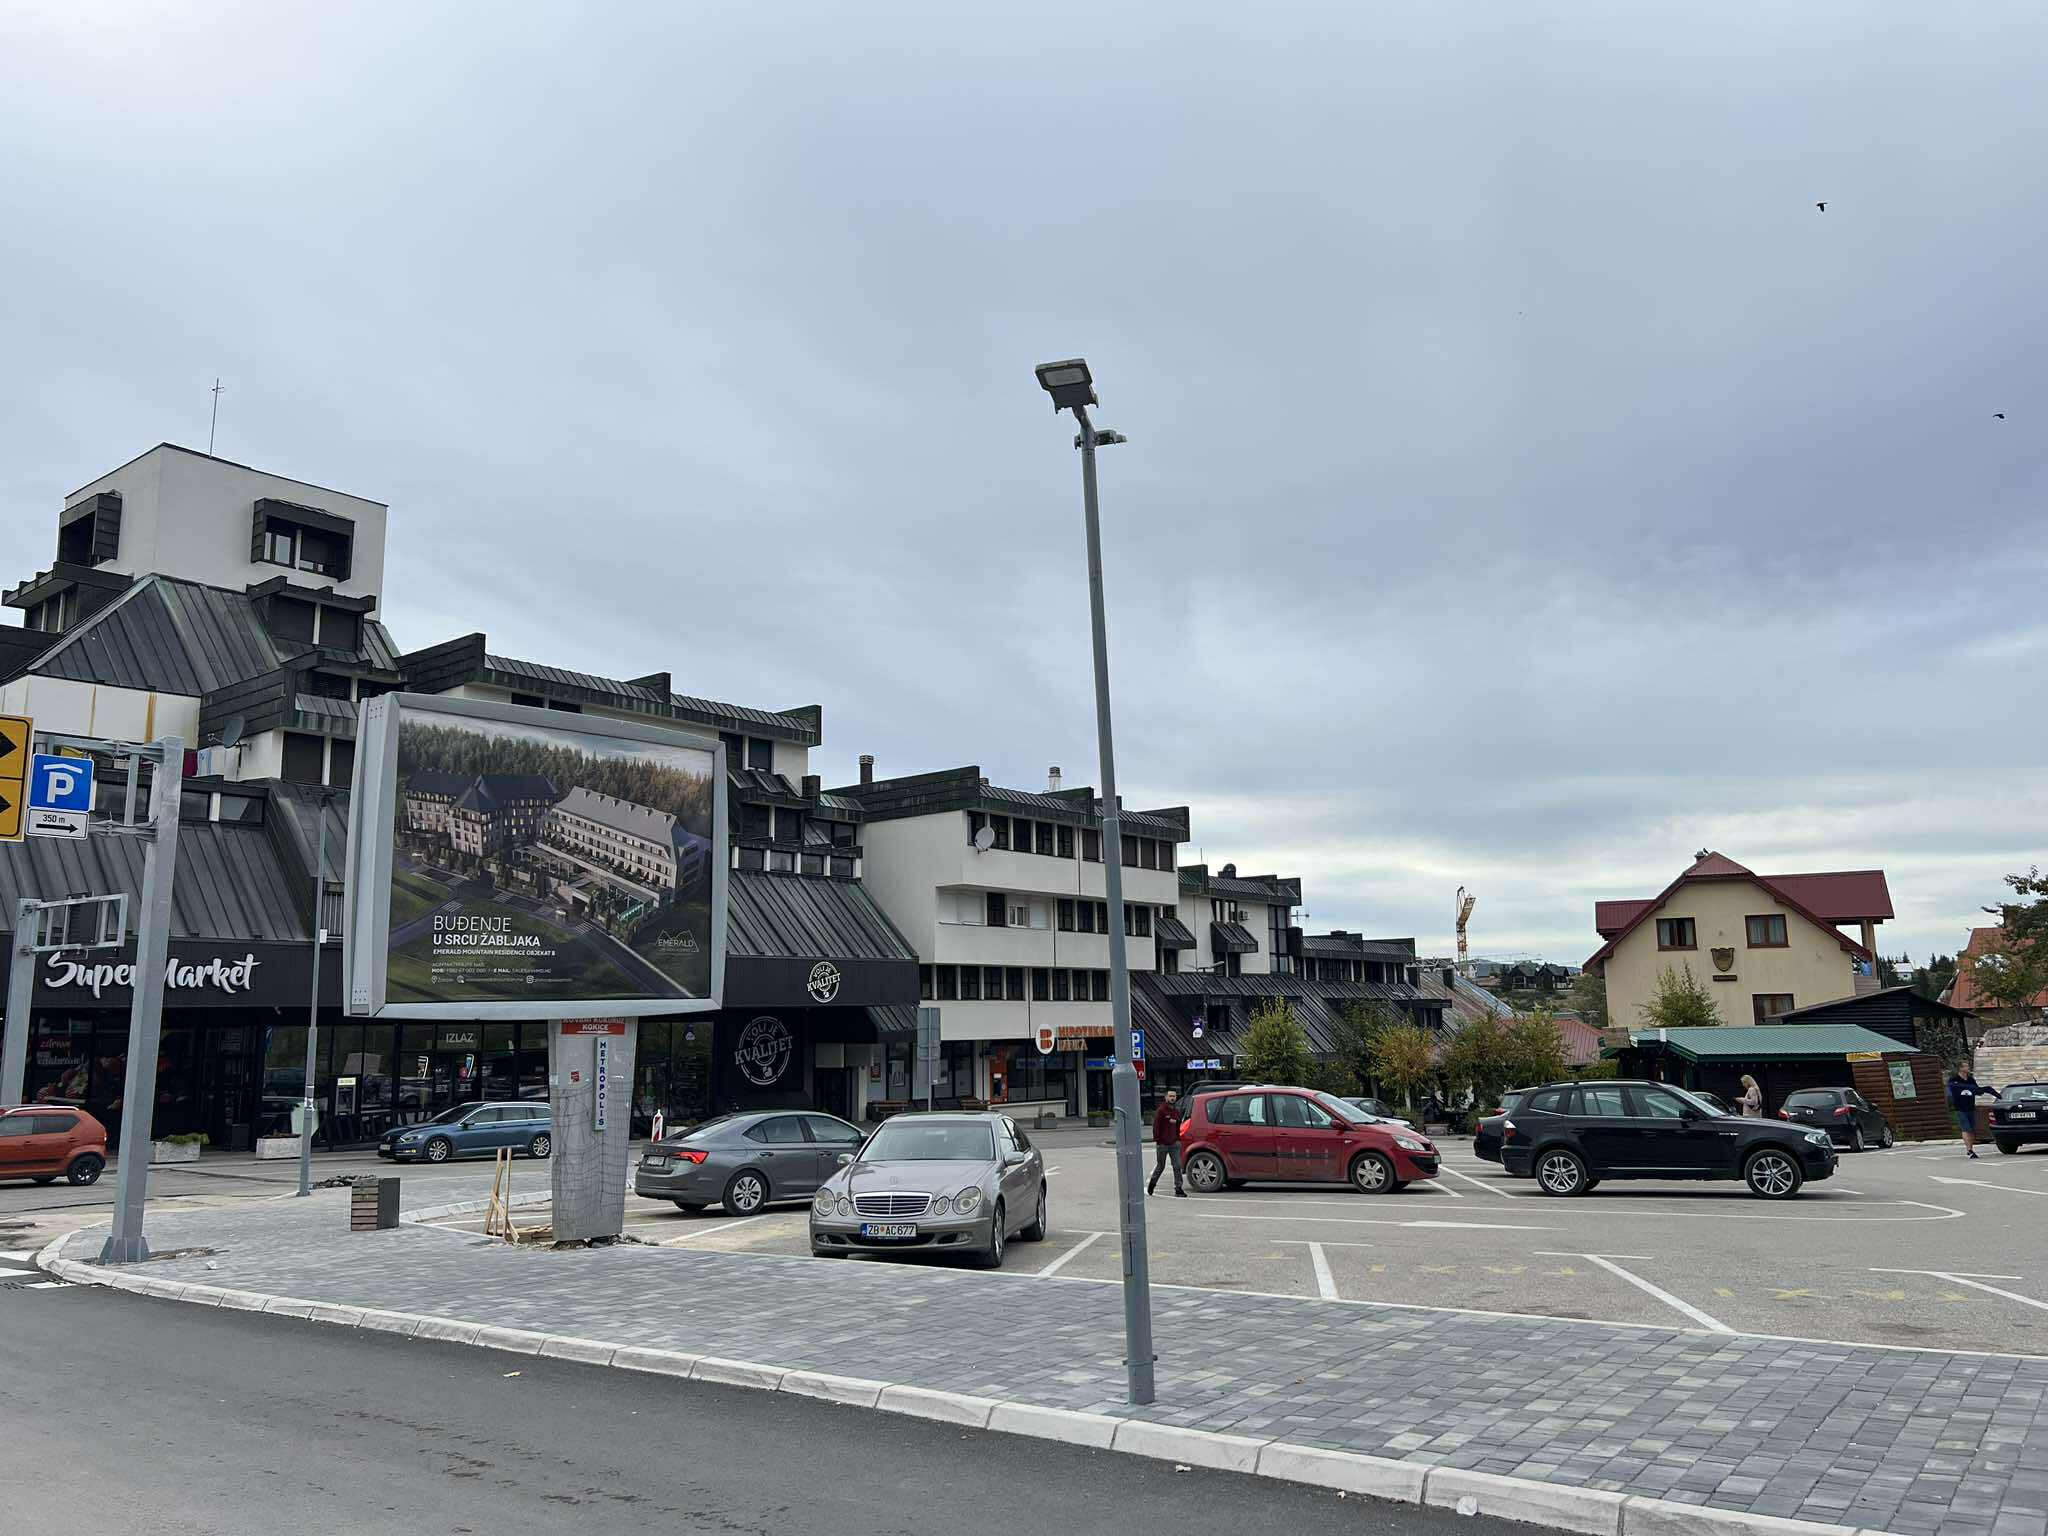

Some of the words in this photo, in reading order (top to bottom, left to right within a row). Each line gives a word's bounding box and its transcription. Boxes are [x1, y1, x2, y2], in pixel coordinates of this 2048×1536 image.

[47, 771, 75, 803] P
[42, 814, 57, 823] 350
[58, 816, 66, 824] m
[433, 915, 512, 932] BUĐENJE
[433, 934, 442, 945] U
[444, 934, 478, 946] SRCU
[480, 932, 541, 947] ŽABLJAKA
[658, 938, 694, 948] EMERALD
[806, 972, 841, 992] KVALITET
[582, 1023, 609, 1031] KOKICE
[446, 1032, 475, 1044] IZLAZ
[734, 1035, 793, 1065] KVALITET
[598, 1041, 607, 1126] METROPOLIS
